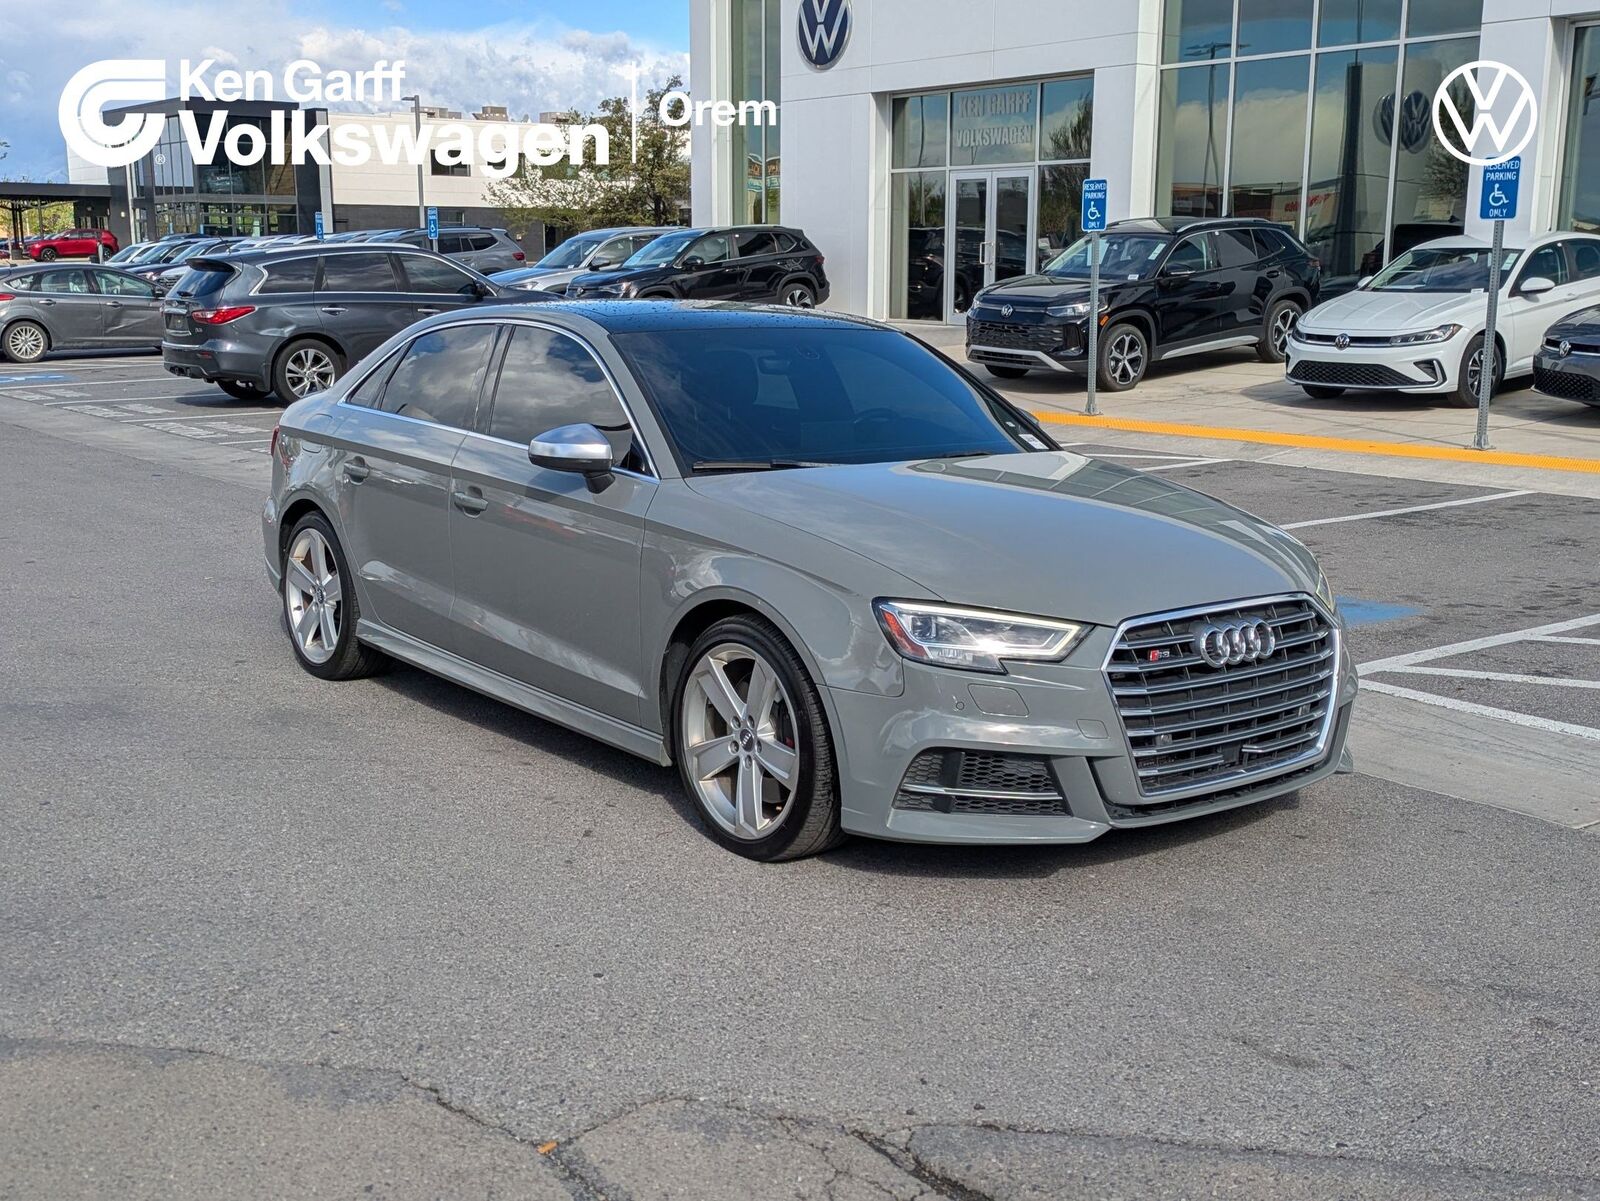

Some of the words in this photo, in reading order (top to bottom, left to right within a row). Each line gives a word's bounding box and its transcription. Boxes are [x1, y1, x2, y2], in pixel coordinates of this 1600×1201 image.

[960, 95, 985, 118] KEN
[990, 89, 1032, 114] GARFF
[956, 125, 1034, 149] VOLKSWAGEN
[1486, 171, 1517, 181] PARKING
[1488, 208, 1508, 217] ONLY
[1087, 221, 1100, 229] ONLY
